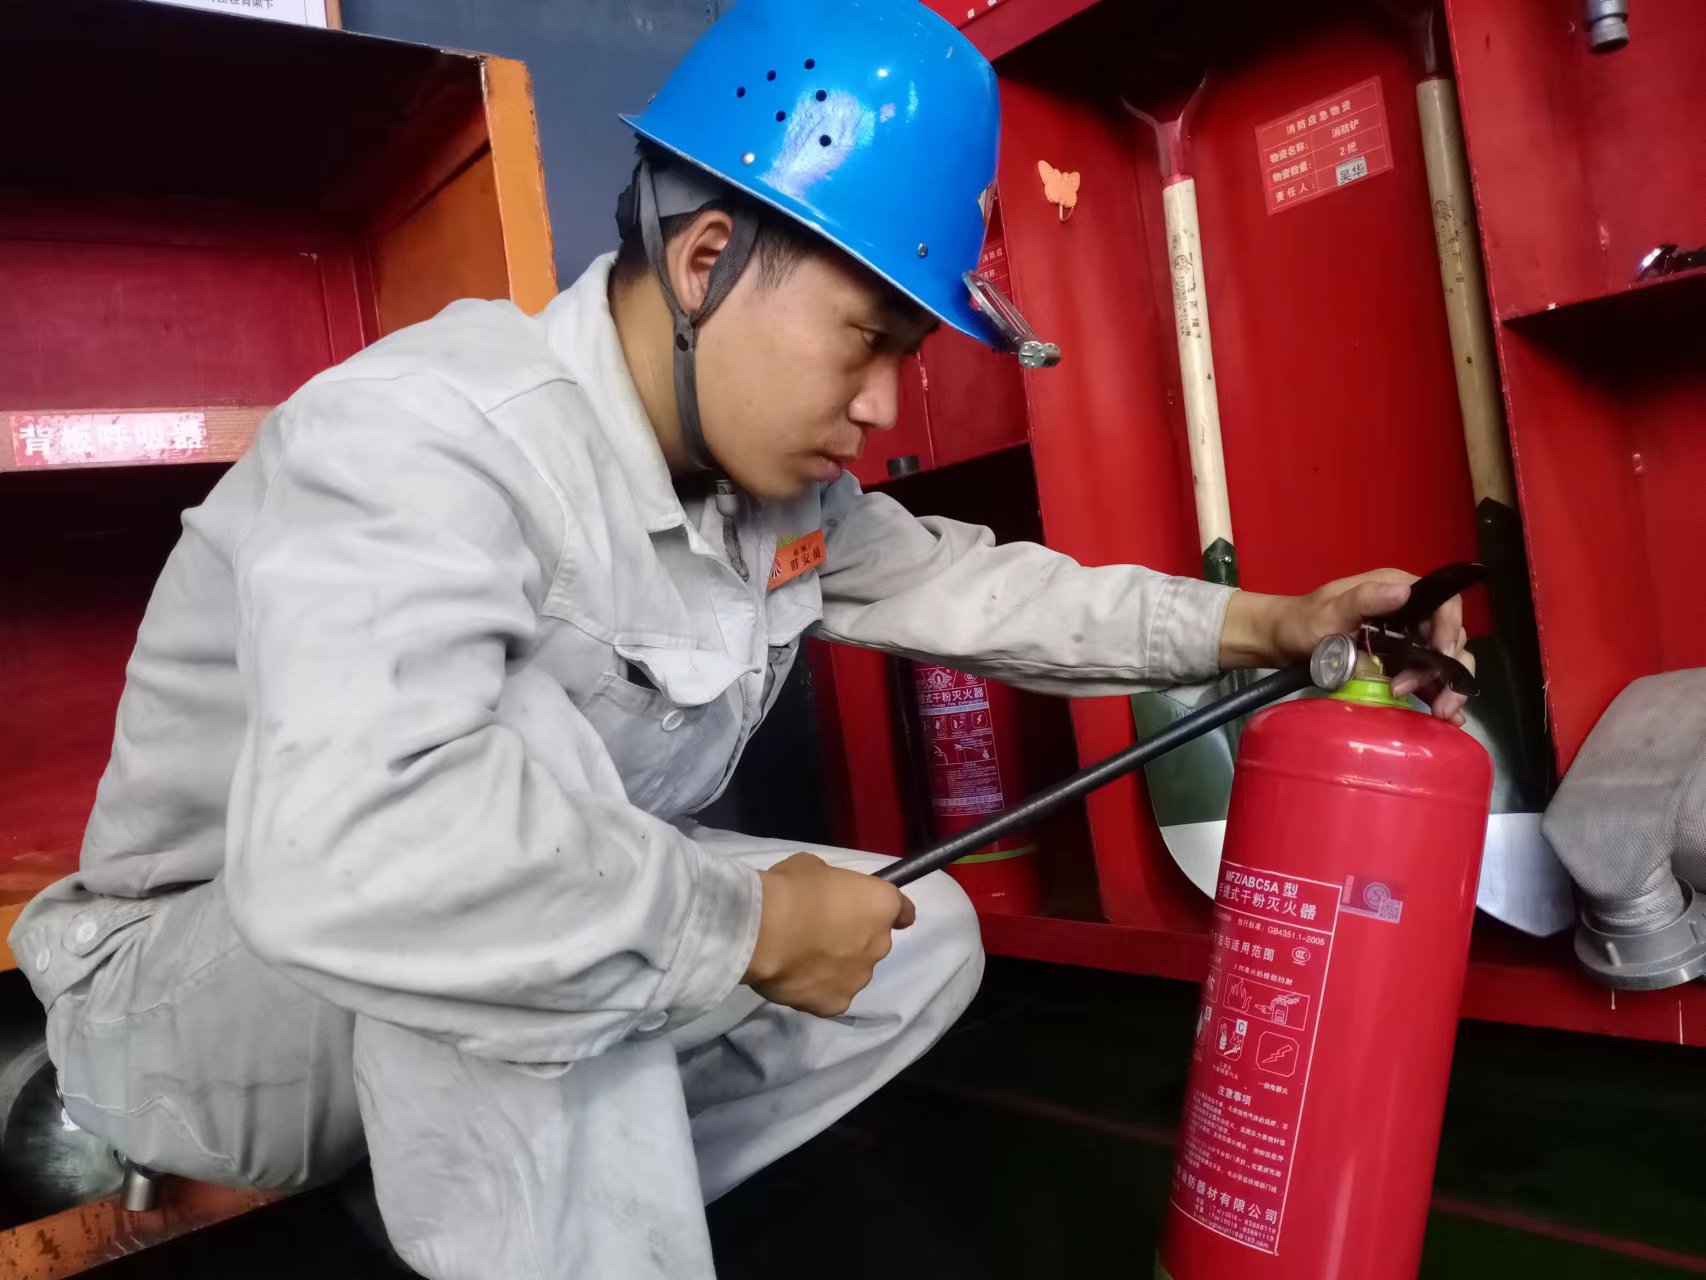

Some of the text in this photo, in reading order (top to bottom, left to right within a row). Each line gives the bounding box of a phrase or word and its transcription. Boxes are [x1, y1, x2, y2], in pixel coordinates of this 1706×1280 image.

[1286, 100, 1351, 135] 消防应急物资
[1331, 119, 1359, 139] 消防铲
[1339, 141, 1358, 156] 2把
[1225, 870, 1299, 899] MFZ/ABC5A 型
[1211, 932, 1275, 962] 方法与适用范围
[1217, 1084, 1252, 1107] 注意事项
